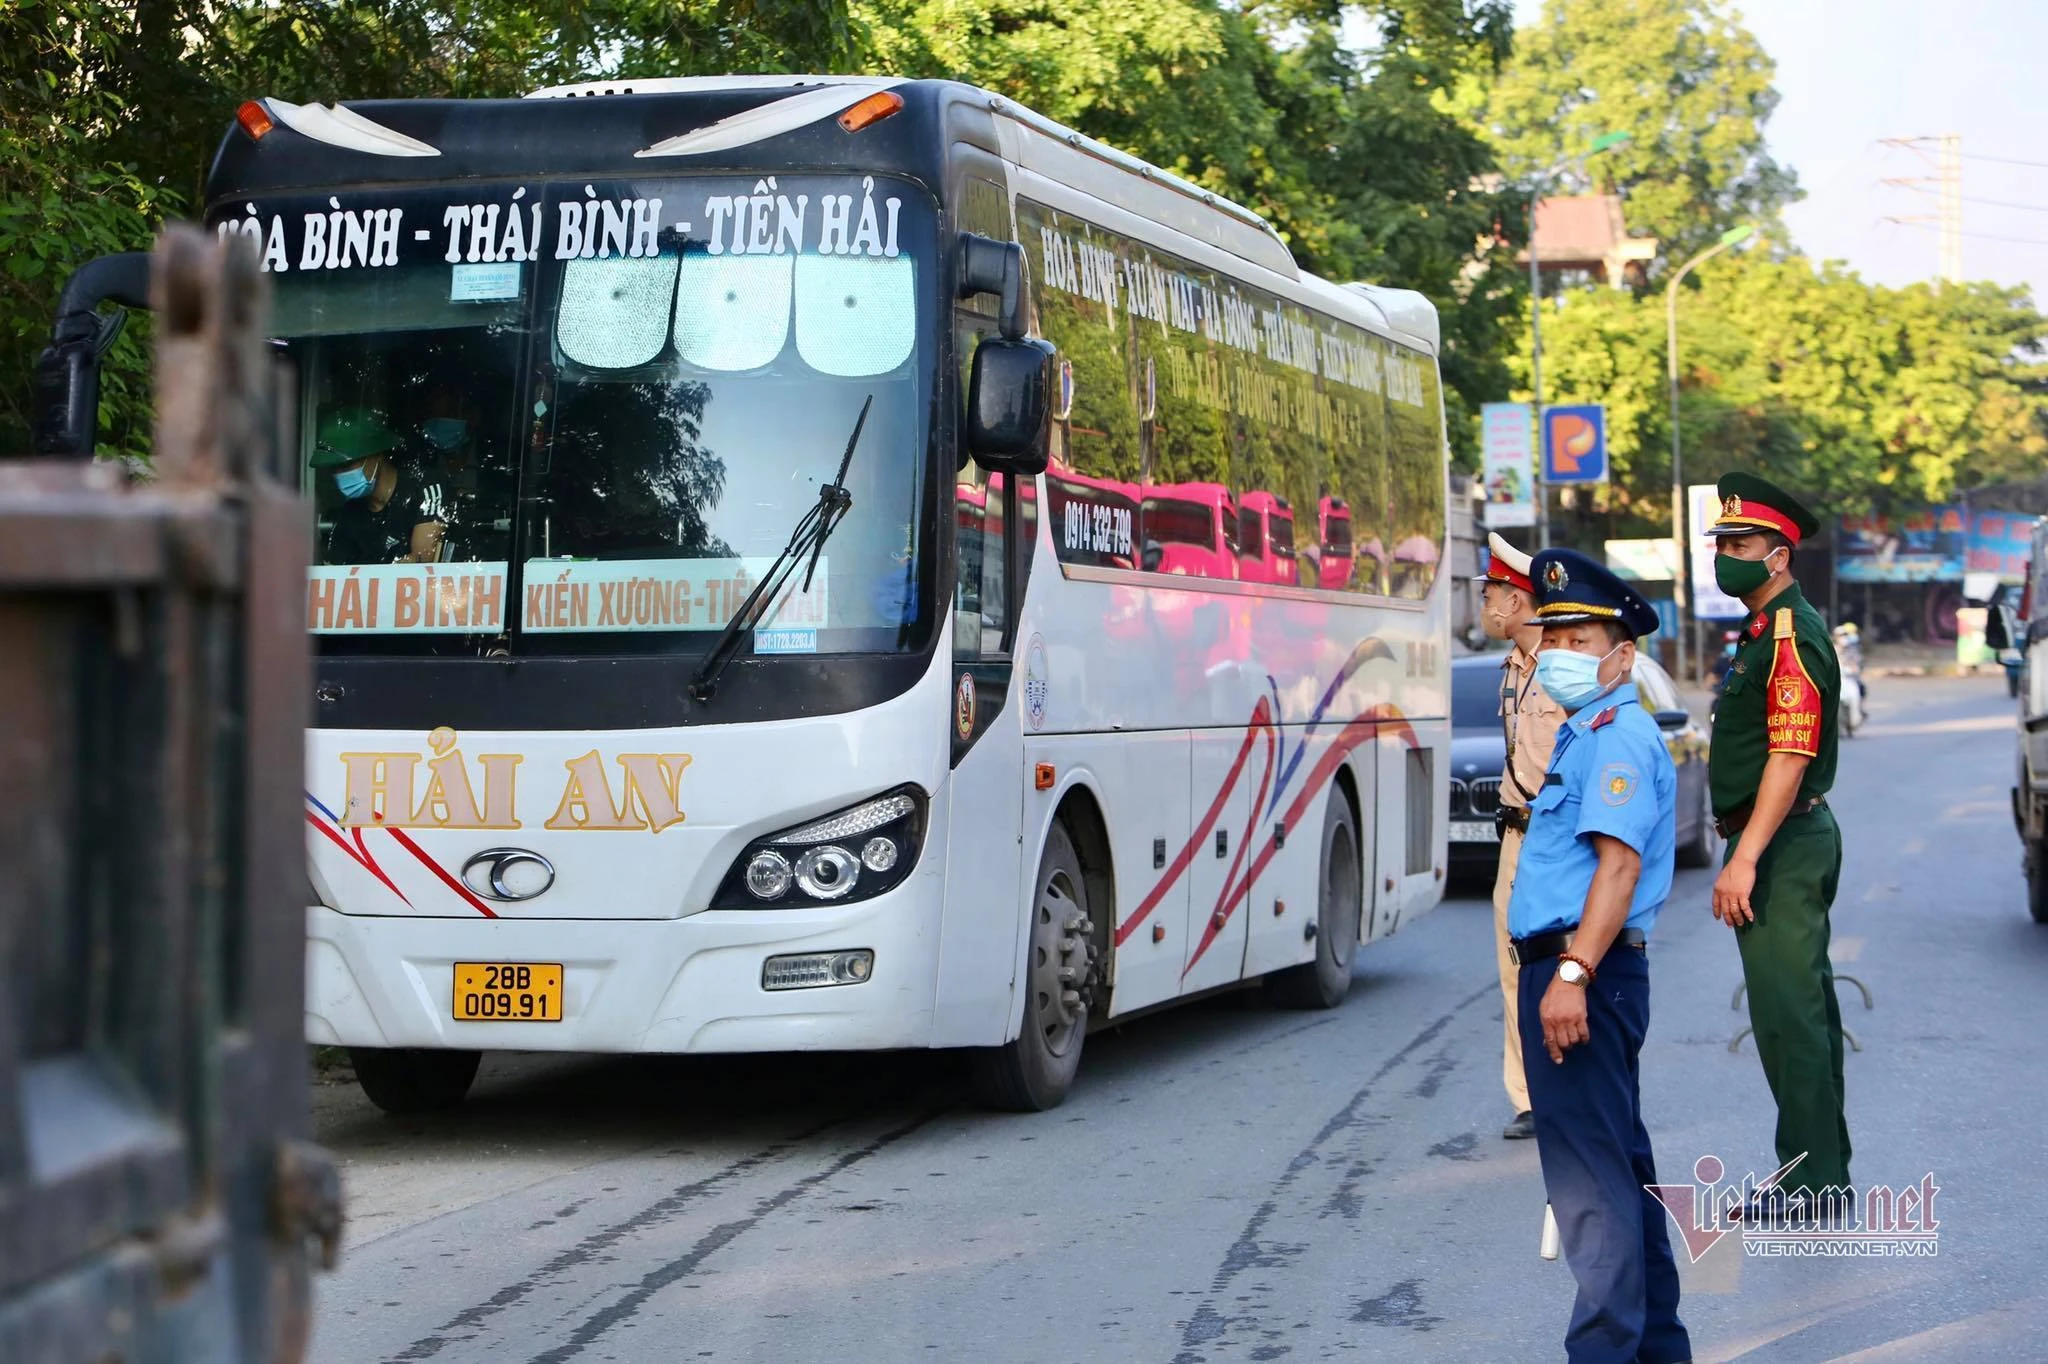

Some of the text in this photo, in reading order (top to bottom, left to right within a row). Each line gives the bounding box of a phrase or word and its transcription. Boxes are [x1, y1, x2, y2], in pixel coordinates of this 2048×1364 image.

[300, 196, 403, 270] BÌNH
[444, 186, 542, 263] THÁI
[555, 184, 663, 260] BÌNH
[705, 176, 808, 256] TIỀN
[818, 175, 902, 258] HẢI
[1065, 500, 1132, 555] 0914 332 799
[394, 565, 502, 628] BÌNH
[526, 568, 590, 628] KIẾN
[1789, 711, 1817, 727] SOÁT
[1796, 729, 1812, 746] SỰ
[338, 726, 693, 834] HẢI AN
[484, 966, 531, 990] 28B
[464, 994, 547, 1018] 009.91
